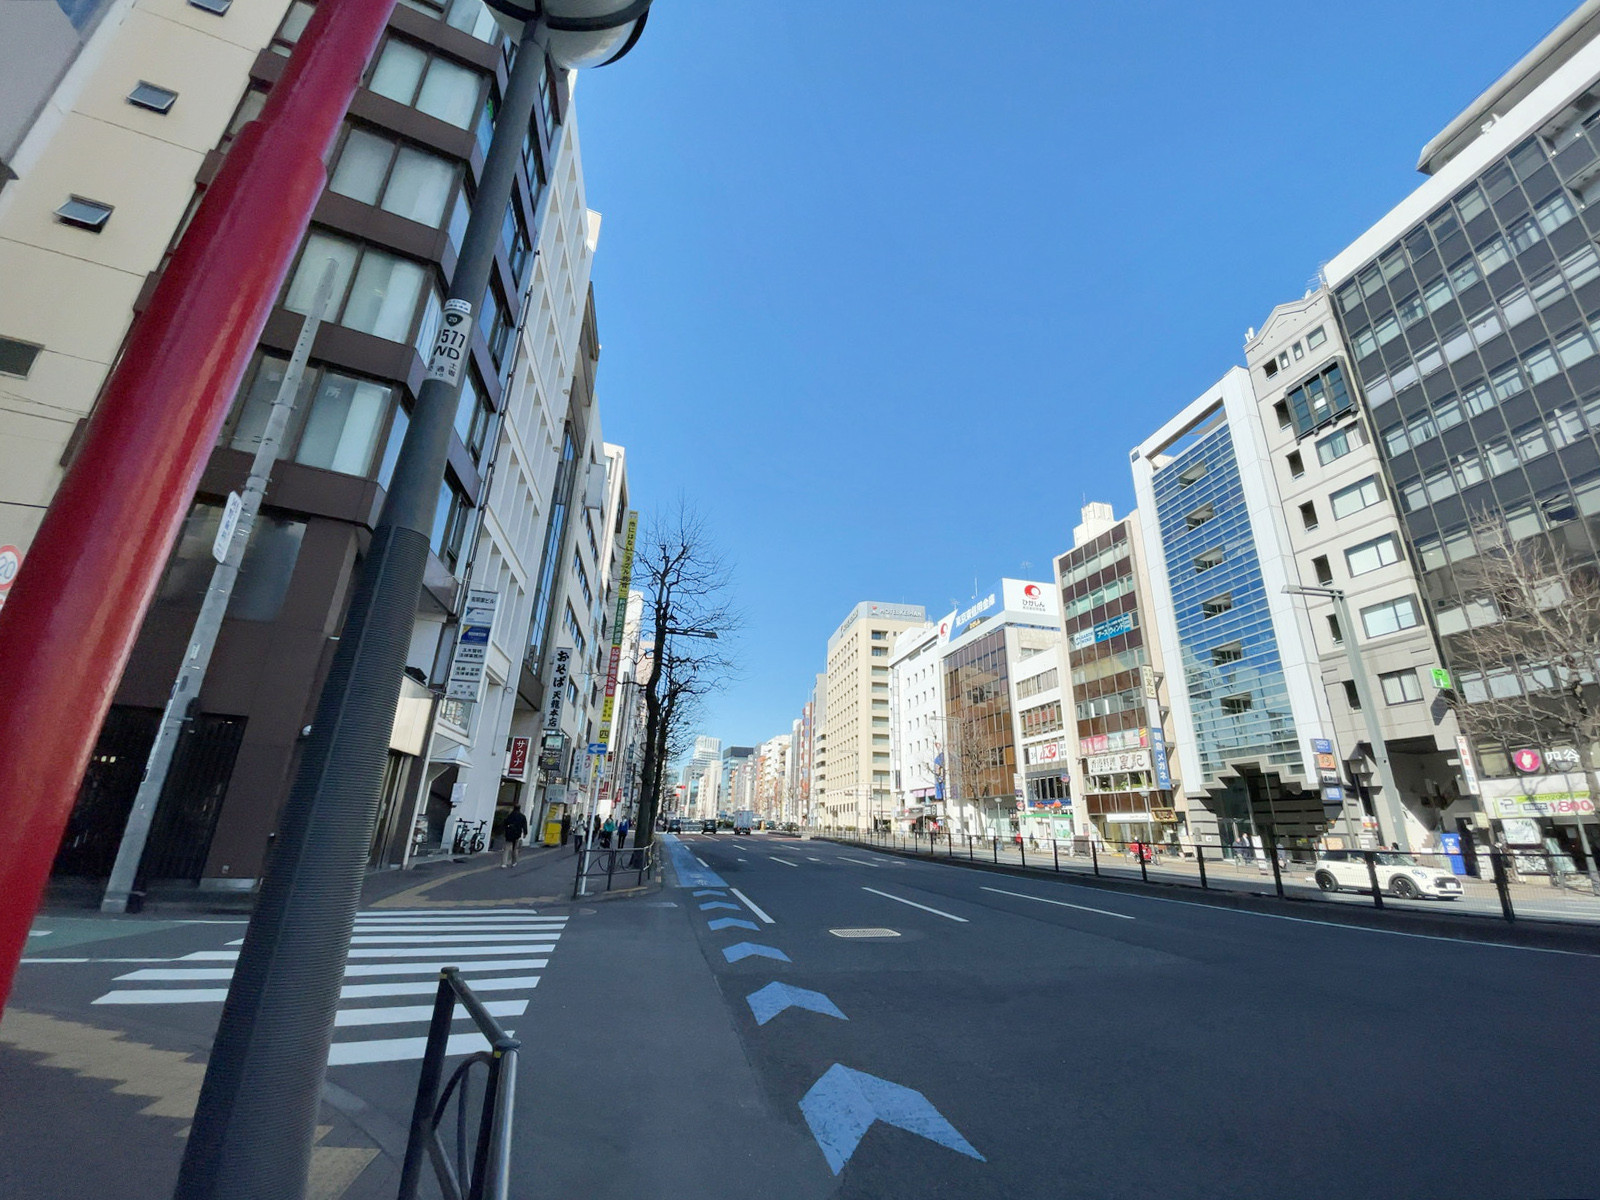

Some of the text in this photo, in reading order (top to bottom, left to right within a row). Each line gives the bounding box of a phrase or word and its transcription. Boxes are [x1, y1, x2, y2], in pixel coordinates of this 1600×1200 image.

[552, 650, 570, 688] おそば
[514, 740, 526, 767] サウナ
